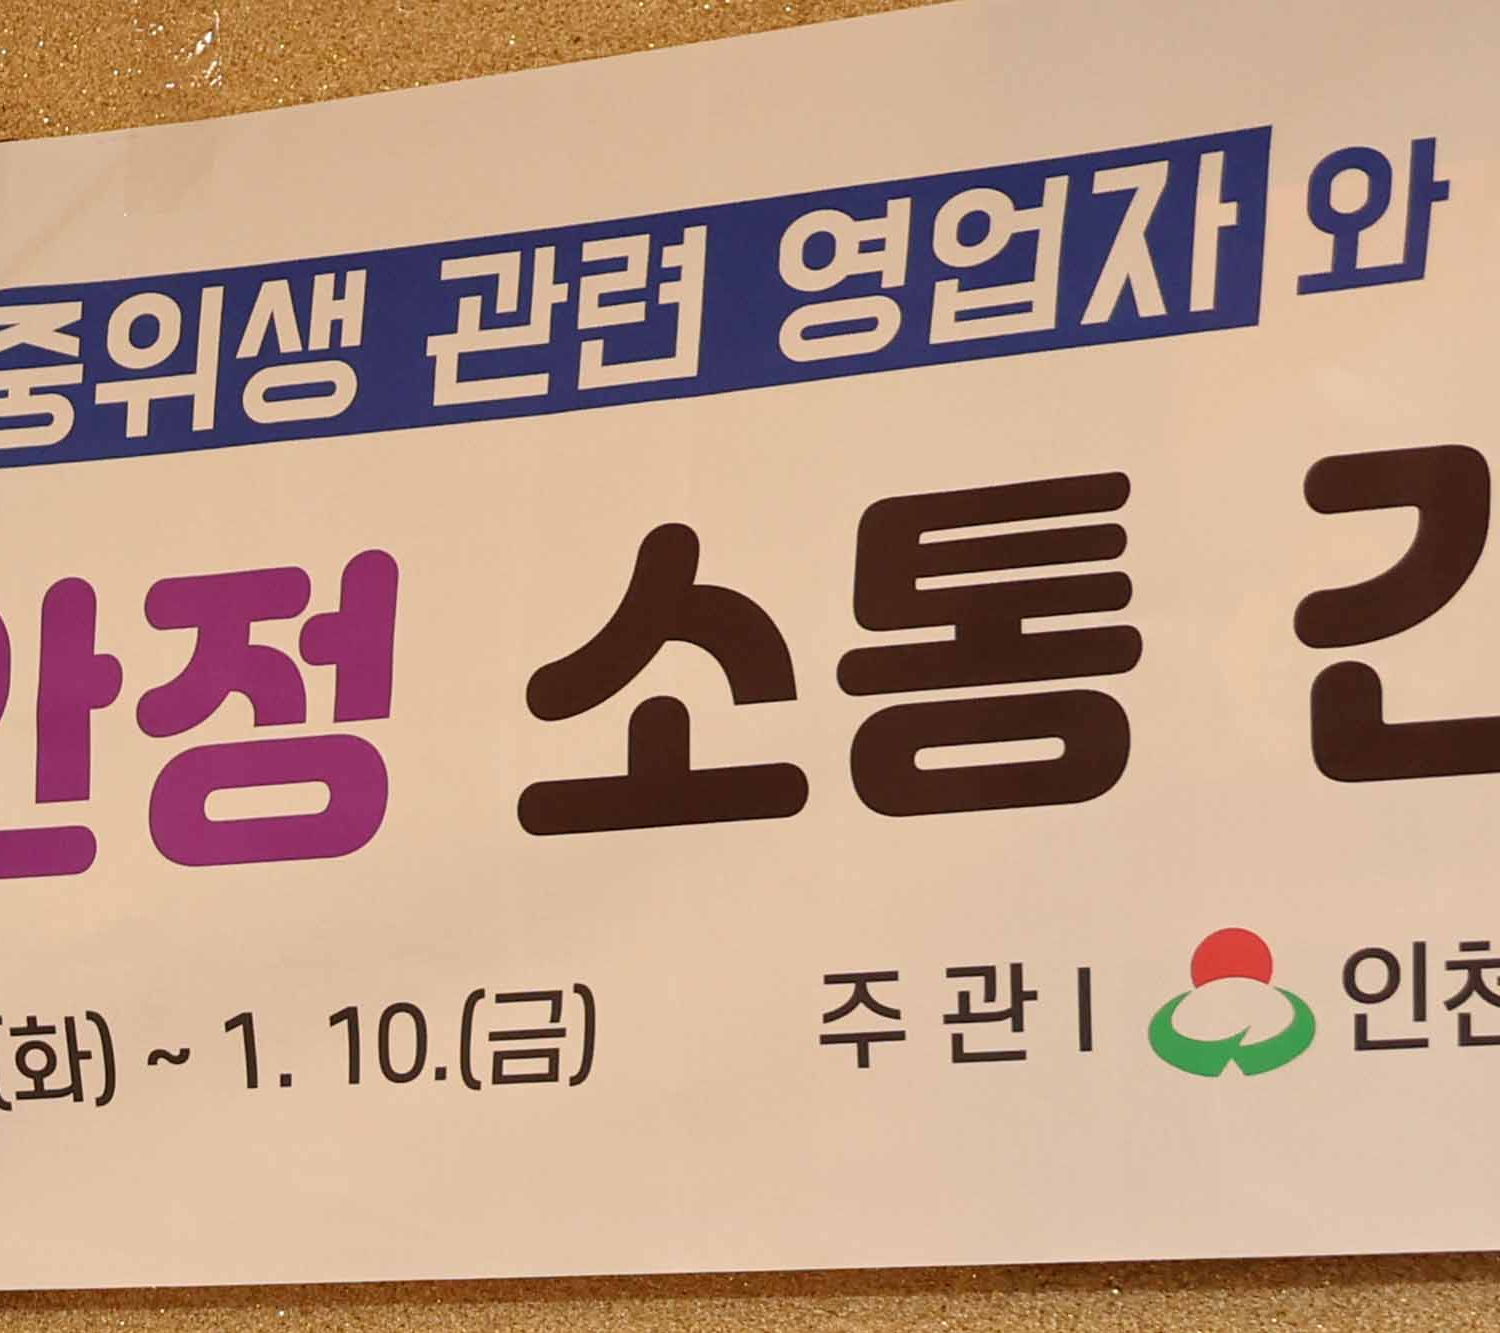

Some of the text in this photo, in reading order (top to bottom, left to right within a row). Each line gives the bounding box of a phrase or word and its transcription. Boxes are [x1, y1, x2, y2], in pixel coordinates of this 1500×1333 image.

[425, 224, 708, 408] 관련
[777, 149, 1239, 363] 영업자
[1295, 136, 1451, 297] 와
[515, 470, 1144, 838] 소통
[223, 1010, 294, 1090] 1.
[327, 981, 597, 1092] 10.(금)
